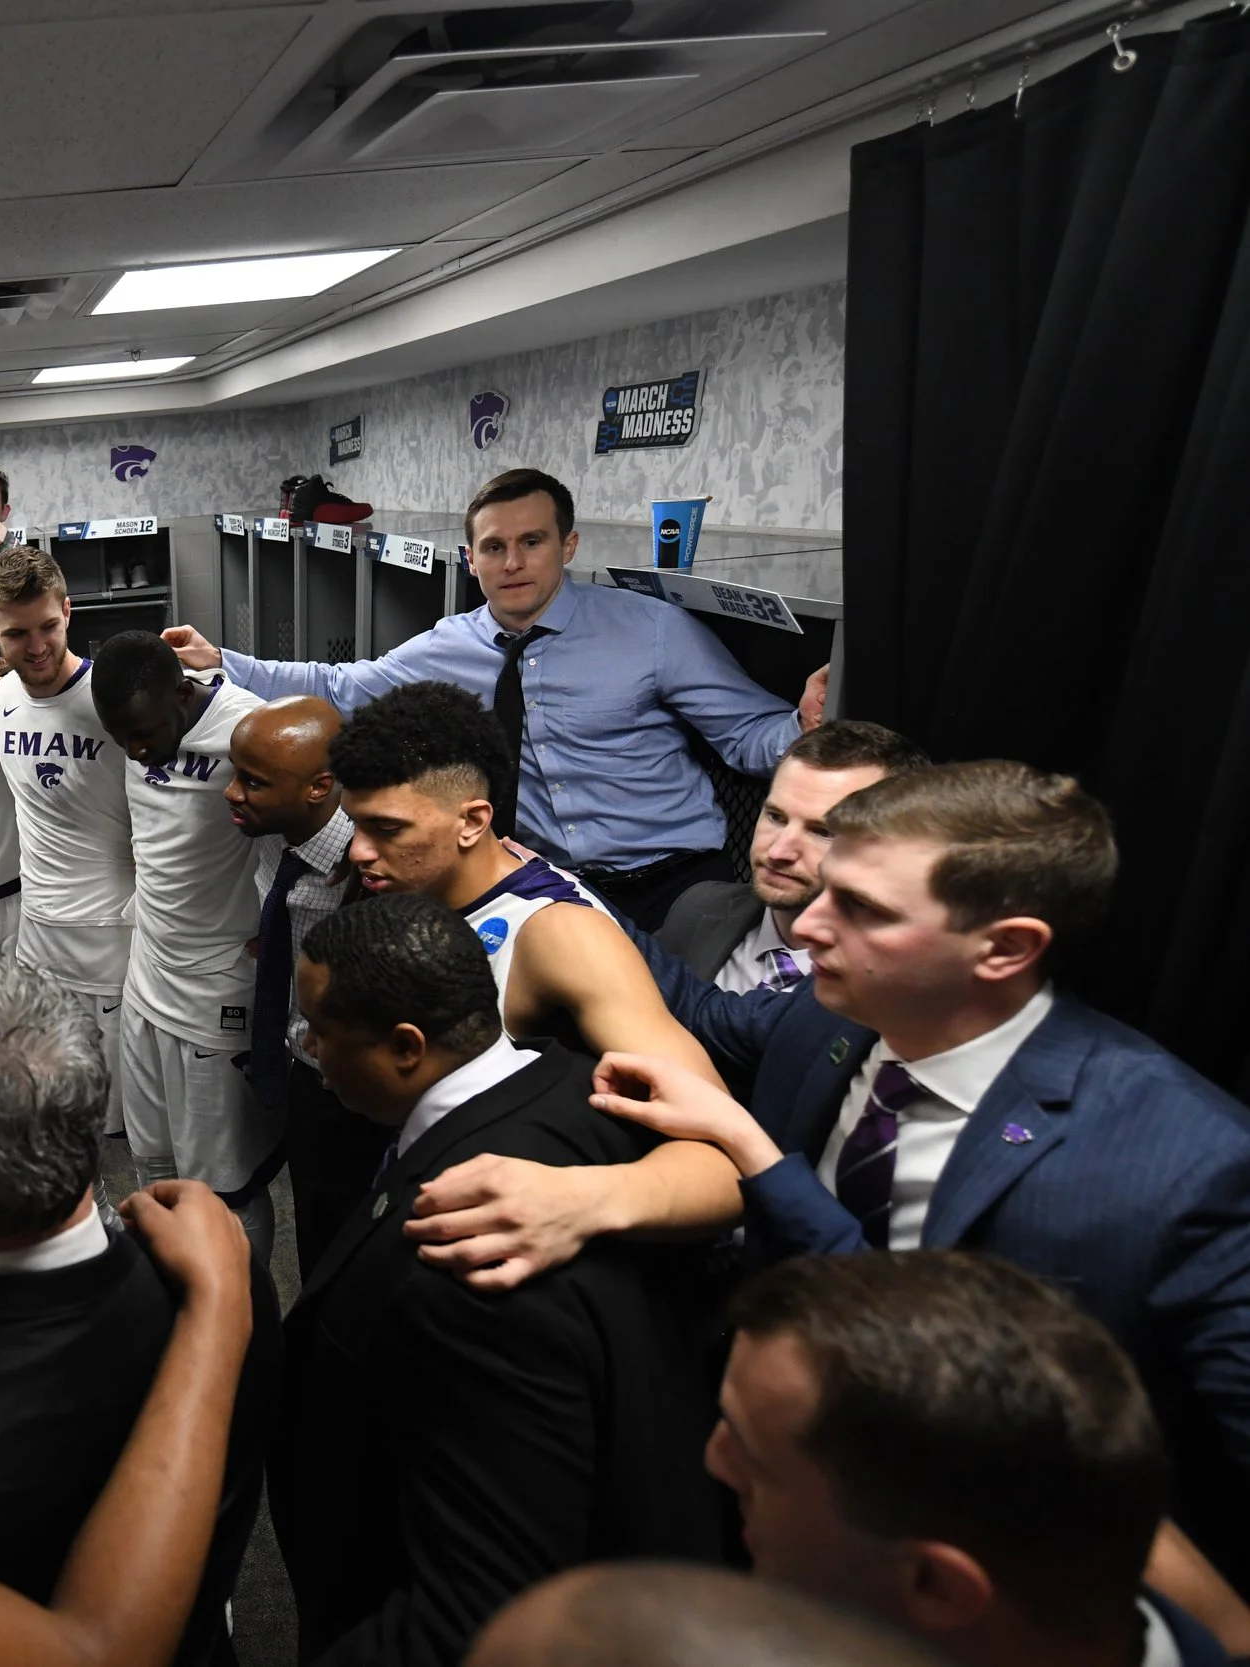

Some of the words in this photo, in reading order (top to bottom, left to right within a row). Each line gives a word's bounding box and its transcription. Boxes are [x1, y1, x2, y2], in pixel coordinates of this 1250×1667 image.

[616, 383, 670, 415] MARCH
[621, 407, 694, 439] MADNESS
[139, 520, 154, 533] 12
[660, 527, 680, 536] NCAA
[684, 506, 699, 562] POWERADE
[344, 531, 350, 550] 3
[403, 541, 423, 556] CARTIER
[404, 552, 422, 567] DIARRA
[421, 546, 430, 568] 2
[711, 585, 745, 602] DEAN
[717, 599, 754, 617] WADE
[744, 592, 788, 626] 32
[3, 730, 106, 761] EMAW
[226, 1008, 240, 1017] 50
